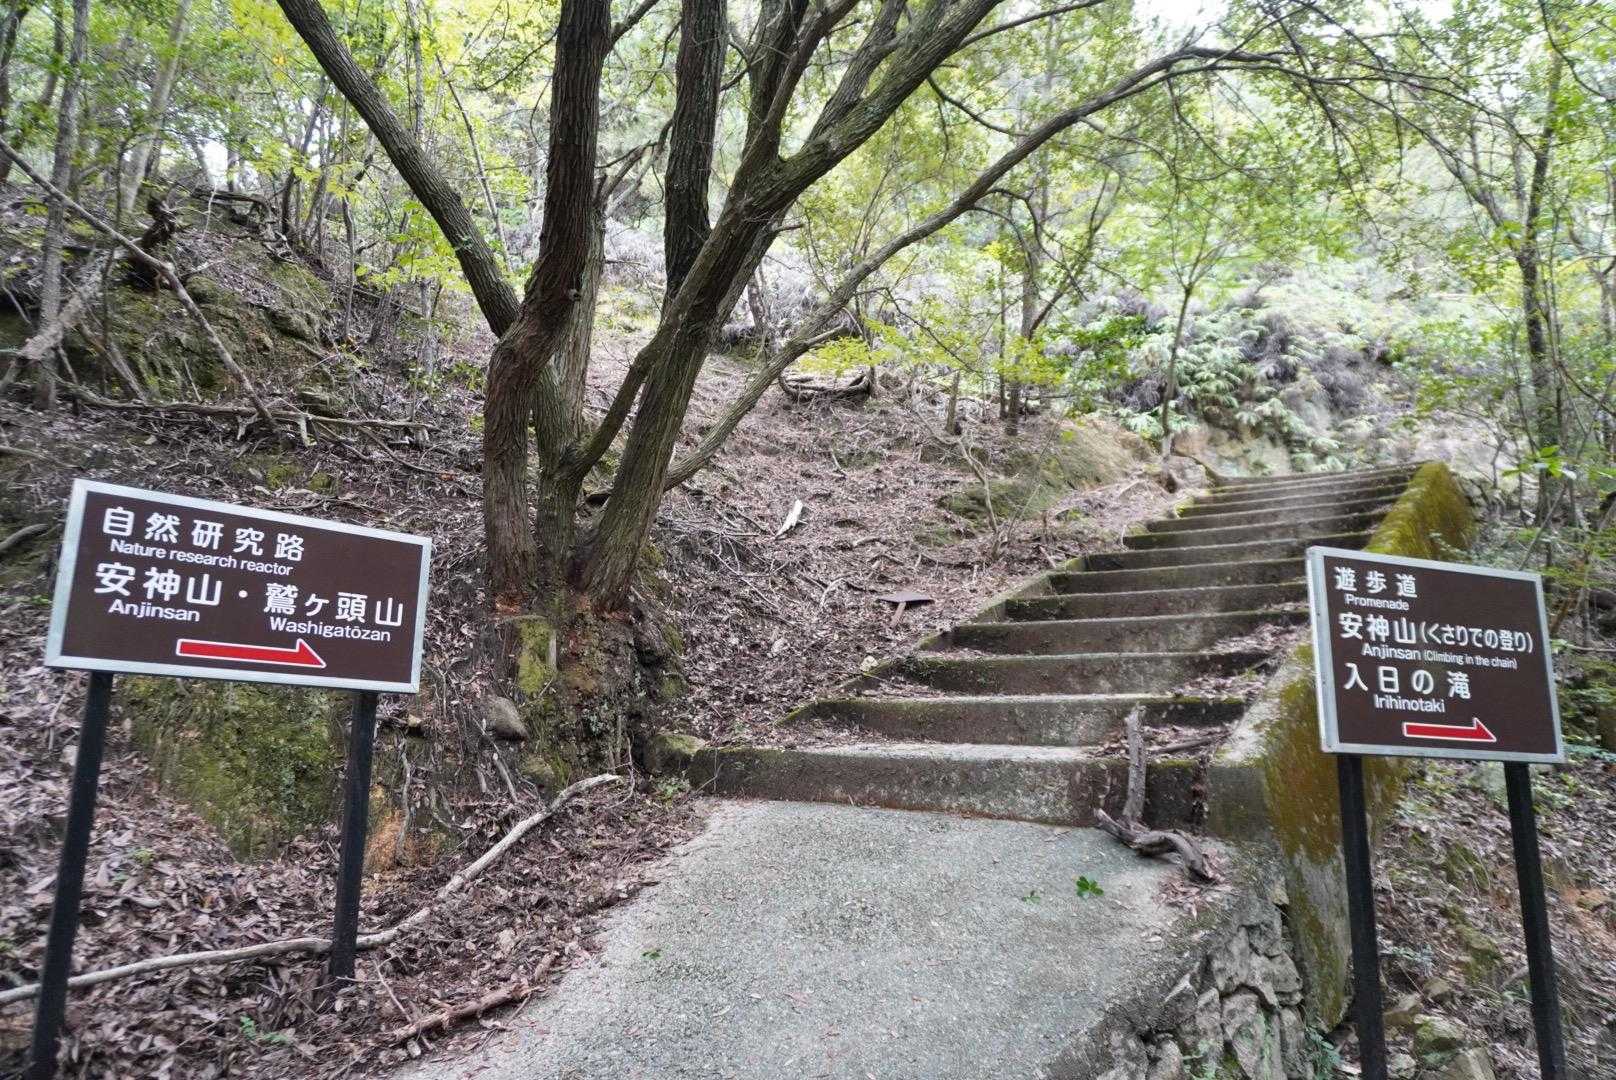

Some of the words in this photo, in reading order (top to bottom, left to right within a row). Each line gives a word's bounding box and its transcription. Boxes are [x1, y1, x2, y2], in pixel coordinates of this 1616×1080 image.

[102, 507, 304, 562] 自然研究路
[110, 539, 166, 559] Nature
[170, 549, 237, 569] research
[240, 560, 293, 576] reactor
[1334, 567, 1417, 598] 遊歩道
[108, 599, 200, 622] Anjinsan
[1345, 595, 1409, 611] Promenade
[1362, 644, 1421, 660] Anjinsan
[1424, 651, 1464, 664] (Climbing
[1466, 655, 1473, 664] in
[1475, 655, 1489, 666] the
[1491, 658, 1518, 669] chain)
[1343, 663, 1471, 699] 入日の滝
[1374, 694, 1445, 712] Irihinotaki
